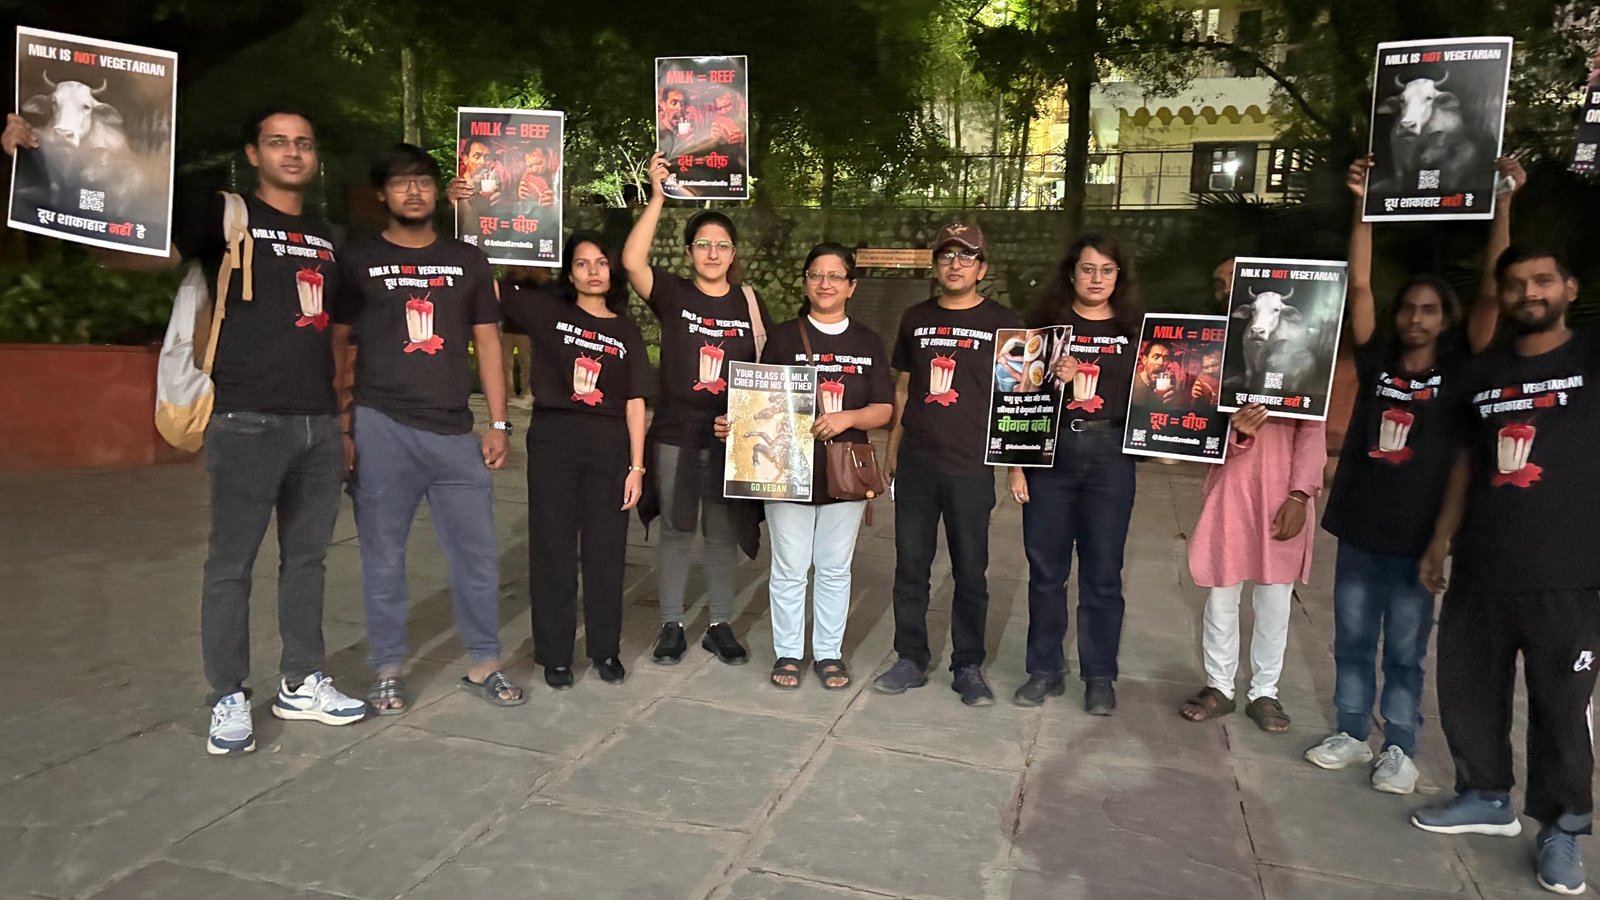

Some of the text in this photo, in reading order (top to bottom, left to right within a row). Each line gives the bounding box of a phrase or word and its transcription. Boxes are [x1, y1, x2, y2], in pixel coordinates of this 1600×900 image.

[29, 43, 165, 77] MILK IS NOT VEGETARIAN
[1385, 49, 1501, 65] MILK IS NOT VEGETARIAN
[667, 70, 694, 84] MILK
[710, 70, 735, 83] BEEF
[471, 122, 550, 138] MILK = BEEF
[678, 155, 693, 171] दूध
[706, 152, 728, 170] बीफ़
[1385, 193, 1474, 211] दूध शाकाहार नहीं है
[38, 208, 146, 239] दूध शाकाहार नहीं है
[479, 216, 498, 235] दूध
[512, 215, 538, 233] बीफ़
[252, 229, 276, 239] MILK
[277, 231, 287, 240] IS
[272, 243, 285, 256] दूध
[287, 246, 318, 258] शाकाहार
[484, 239, 533, 249] @AnimalSaveIndia
[369, 265, 463, 277] MILK IS NOT VEGETARIAN
[1241, 268, 1339, 281] MILK IS NOT VEGETARIAN
[384, 278, 397, 290] दूध
[398, 278, 428, 288] शाकाहार
[446, 276, 453, 286] है
[556, 322, 574, 332] MILK
[574, 327, 582, 335] IS
[582, 330, 597, 339] NOT
[716, 319, 750, 329] VEGETARIAN
[953, 328, 993, 341] VEGETARIAN
[1153, 326, 1184, 339] MILK
[1201, 328, 1226, 342] BEE
[564, 335, 575, 344] दूध
[575, 338, 604, 352] शाकाहार
[921, 338, 929, 348] दूध
[930, 338, 957, 347] शाकाहार
[821, 354, 834, 362] NOT
[835, 355, 872, 366] VEGETARIAN
[736, 368, 753, 378] YOUR
[755, 371, 778, 380] GLASS
[792, 373, 809, 381] MILK
[734, 377, 753, 387] CRIED
[755, 380, 768, 388] FOR
[770, 381, 781, 389] HIS
[1491, 389, 1501, 398] IS
[1522, 376, 1583, 394] VEGETARIAN
[1236, 393, 1311, 408] दूध शाकाहार नहीं है
[1480, 404, 1492, 418] दूध
[1493, 398, 1533, 412] शाकाहार
[1557, 392, 1568, 405] है
[998, 416, 1050, 432] वीगन बनें।
[1150, 412, 1169, 430] दूध
[1182, 412, 1209, 431] बीफ़
[1152, 434, 1200, 445] @AnimalSaveIndia
[751, 483, 760, 491] GO
[763, 483, 787, 492] VEGAN
